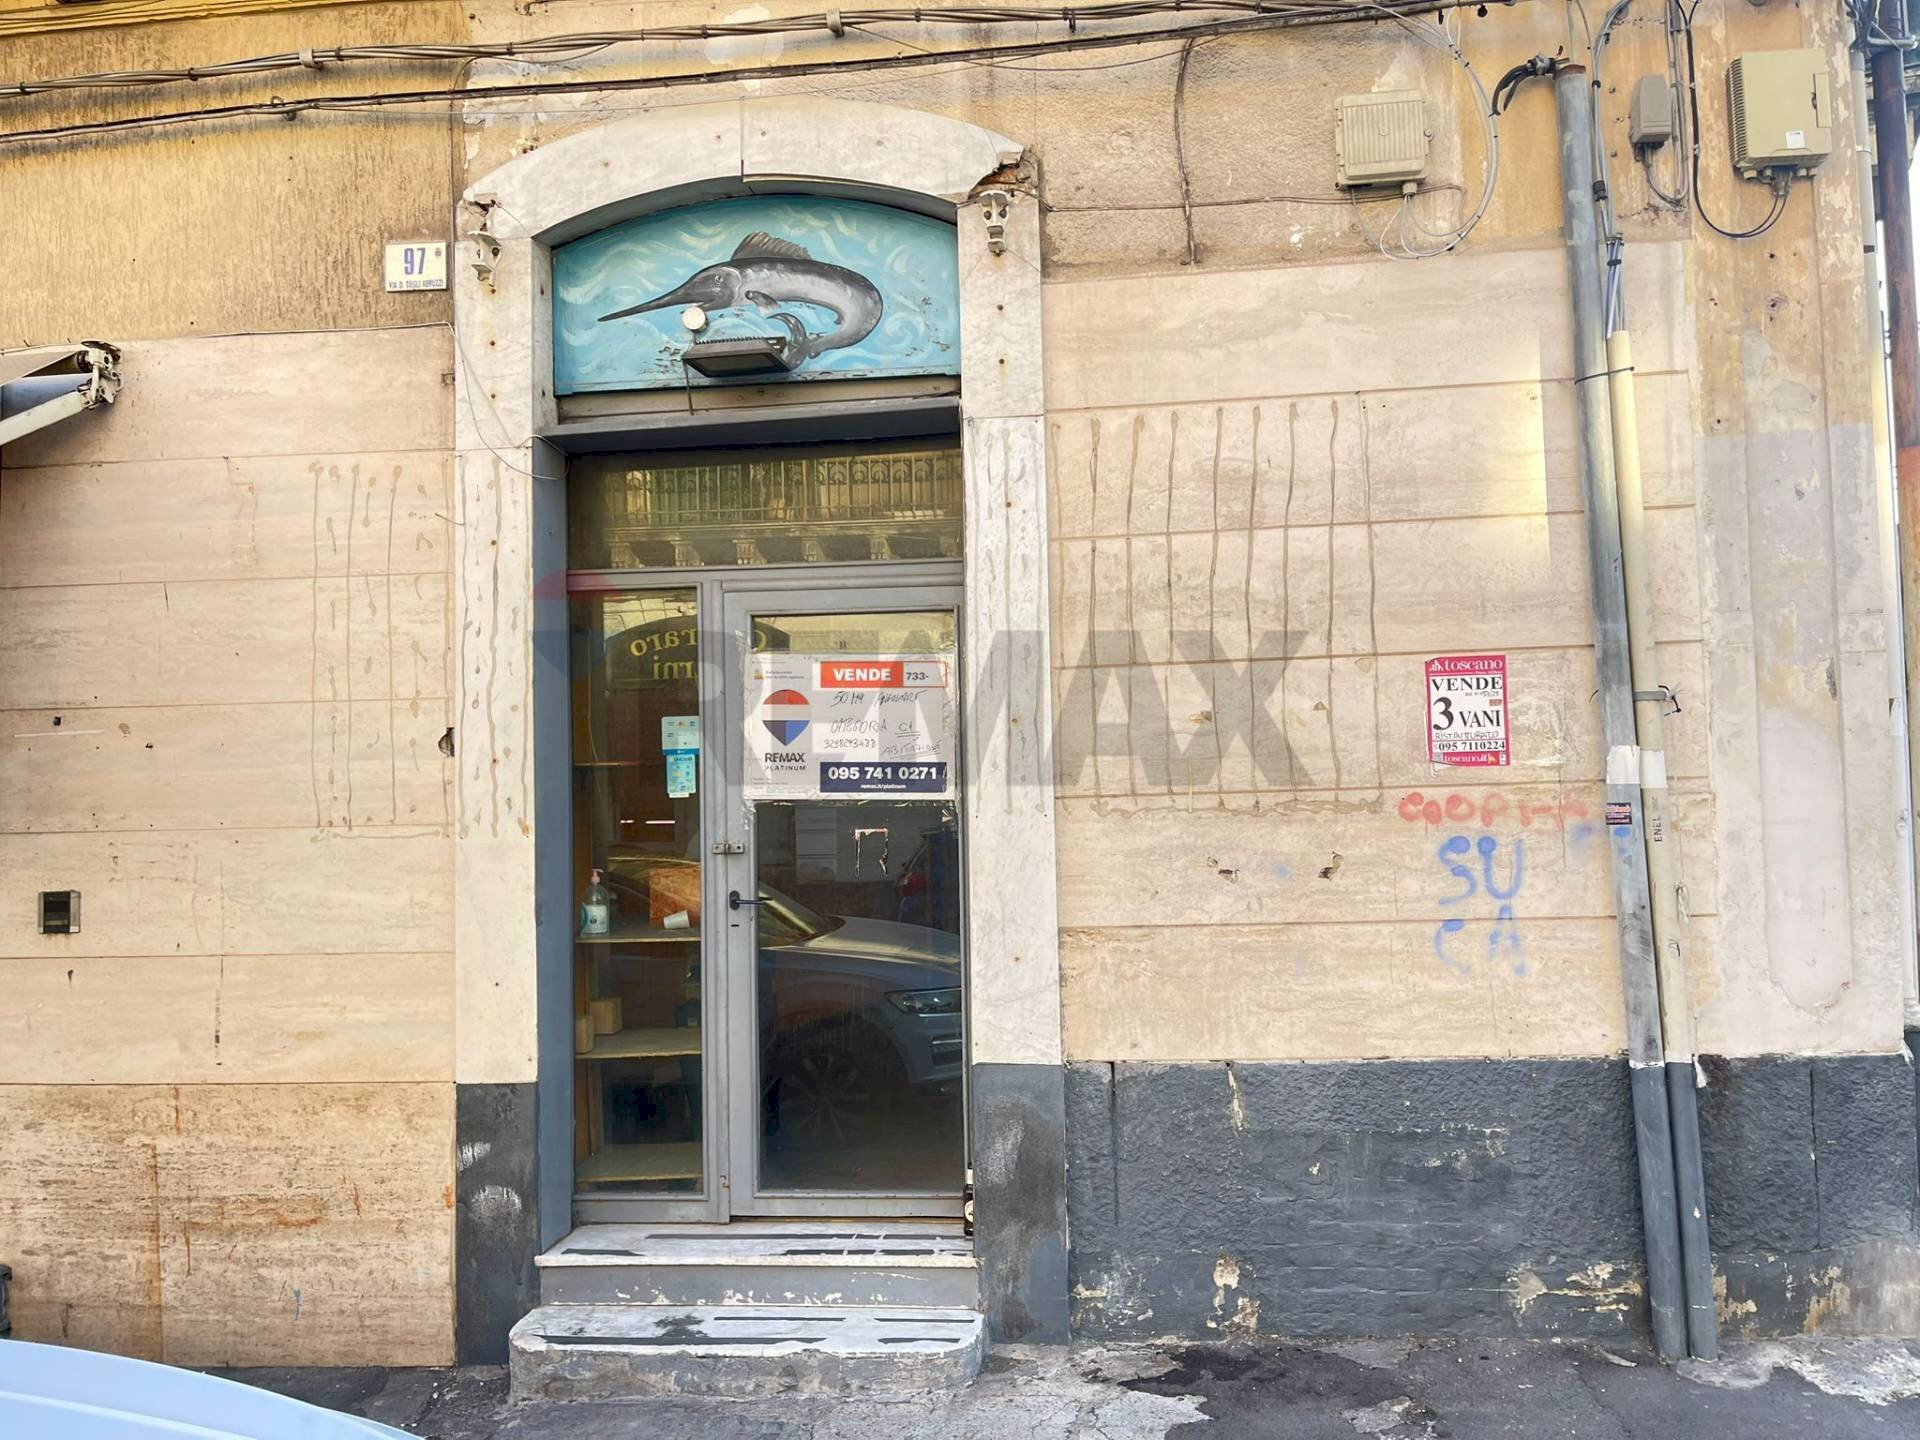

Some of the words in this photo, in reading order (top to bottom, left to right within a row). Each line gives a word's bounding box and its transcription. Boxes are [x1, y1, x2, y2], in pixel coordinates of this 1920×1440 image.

[404, 247, 426, 275] 97
[388, 280, 397, 289] VIA
[1445, 658, 1503, 671] toscano
[833, 668, 892, 682] VENDE
[1431, 676, 1503, 692] VENDE
[1433, 696, 1454, 731] 3
[1459, 710, 1502, 728] VANI
[1438, 742, 1458, 752] 095
[1461, 741, 1505, 751] 7110224
[764, 752, 805, 763] REMAX
[828, 766, 860, 780] 095
[864, 766, 892, 780] 741
[898, 766, 937, 780] 0271
[1652, 815, 1663, 843] ENEL
[1437, 835, 1525, 906] SU
